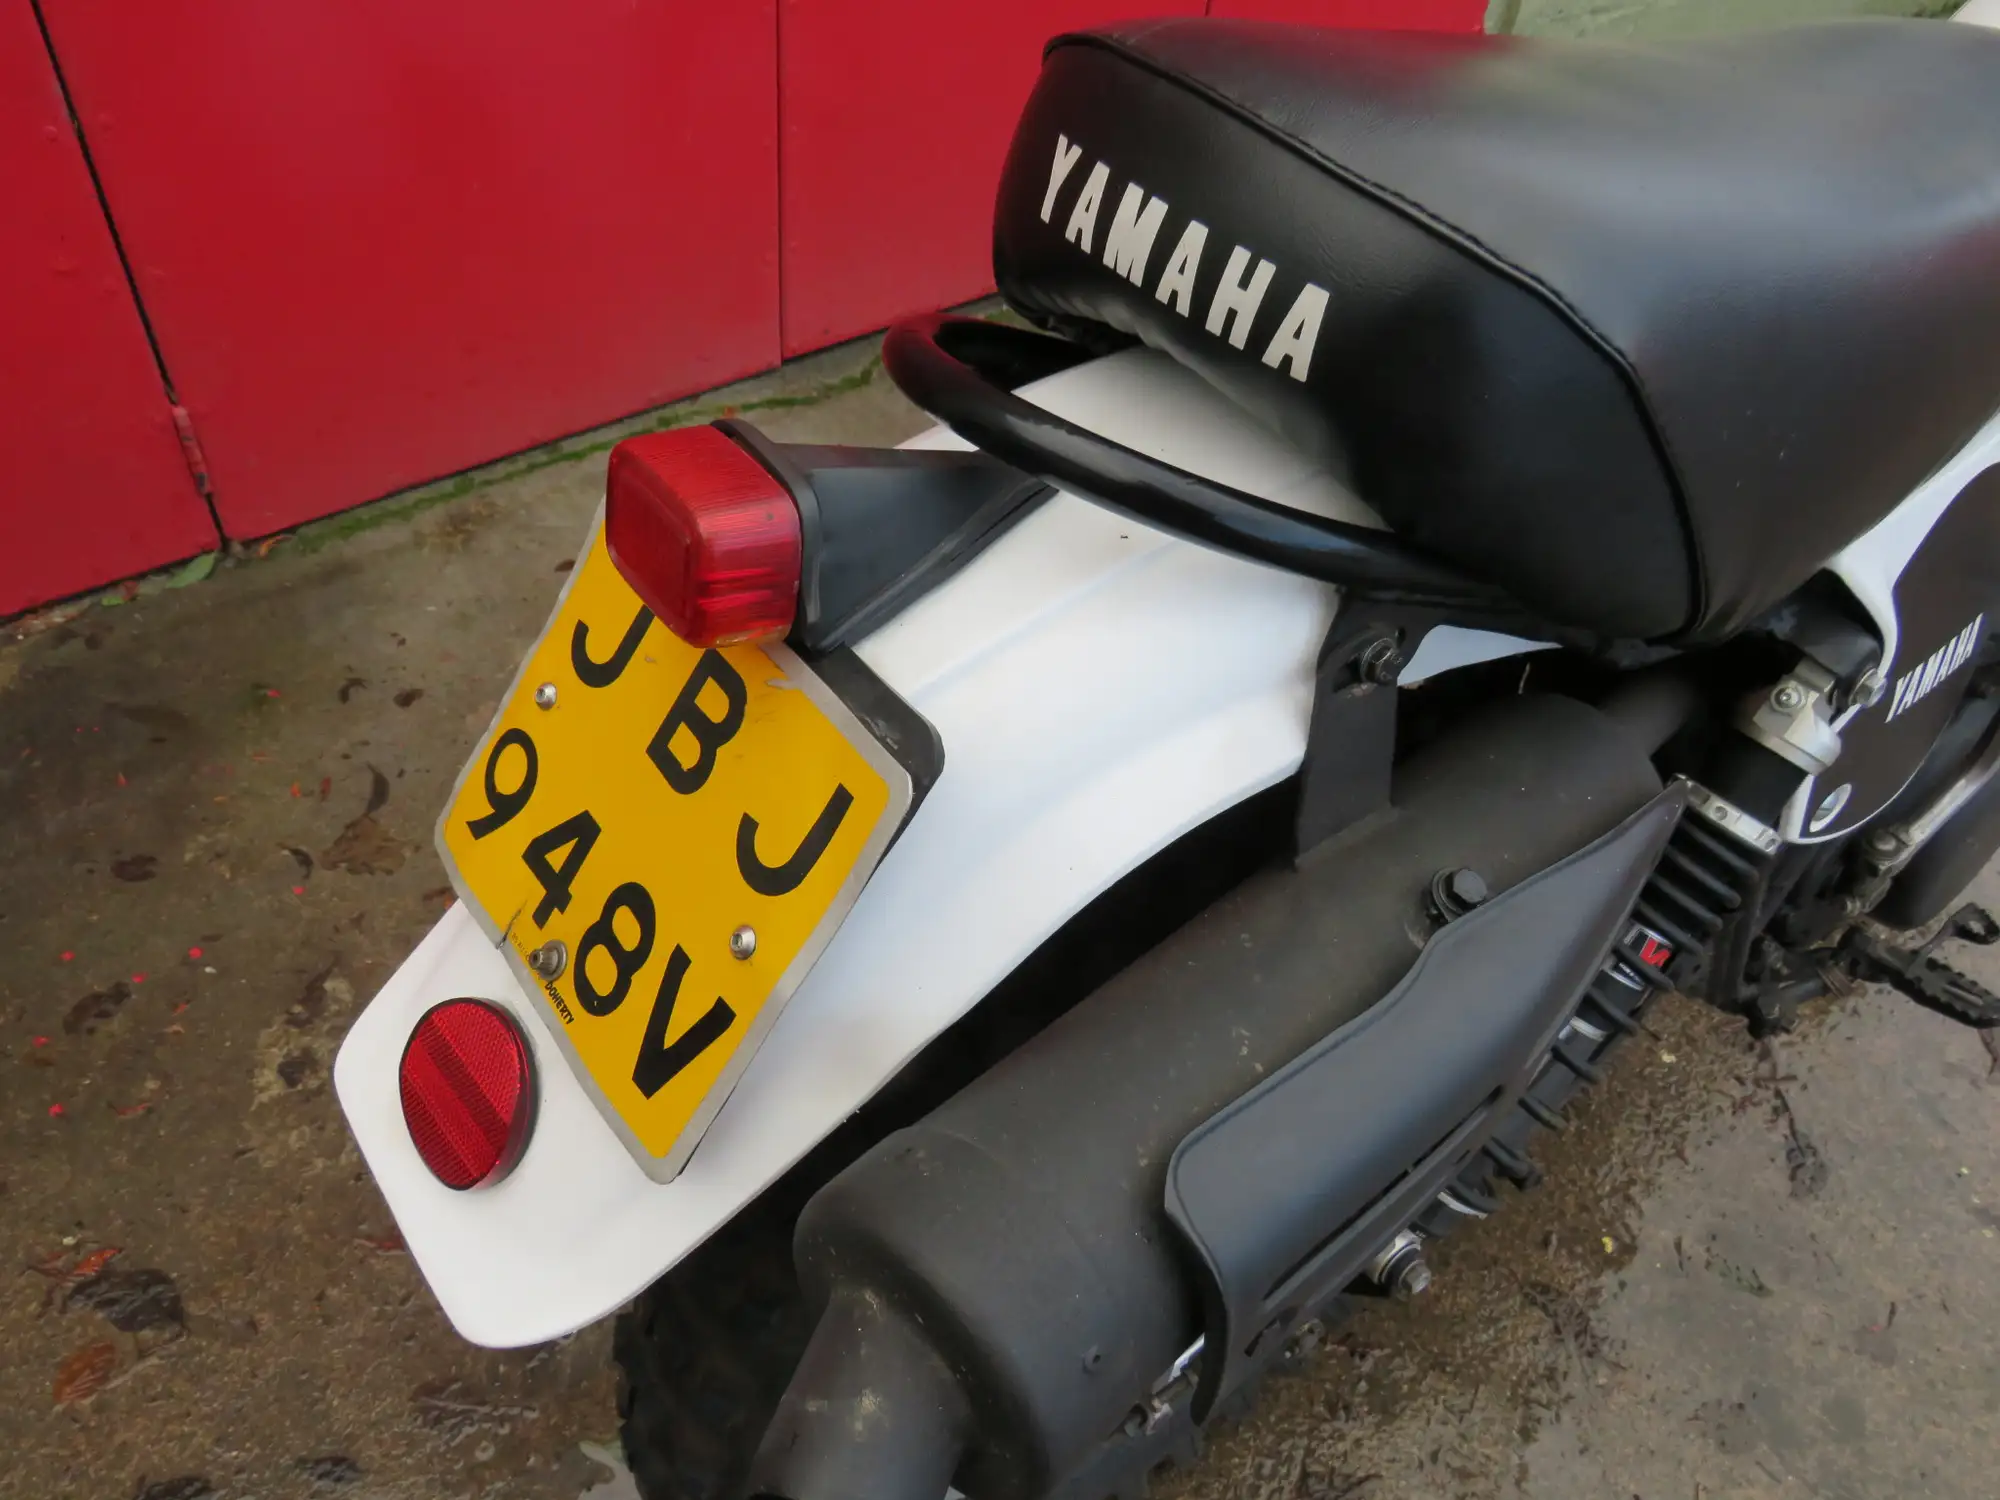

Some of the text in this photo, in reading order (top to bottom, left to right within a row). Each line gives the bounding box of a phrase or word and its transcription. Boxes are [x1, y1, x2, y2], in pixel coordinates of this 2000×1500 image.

[1040, 133, 1330, 383] YAMAHA
[571, 604, 854, 896] JBJ
[1884, 612, 1984, 723] YAMAHA
[466, 728, 737, 1100] 948V
